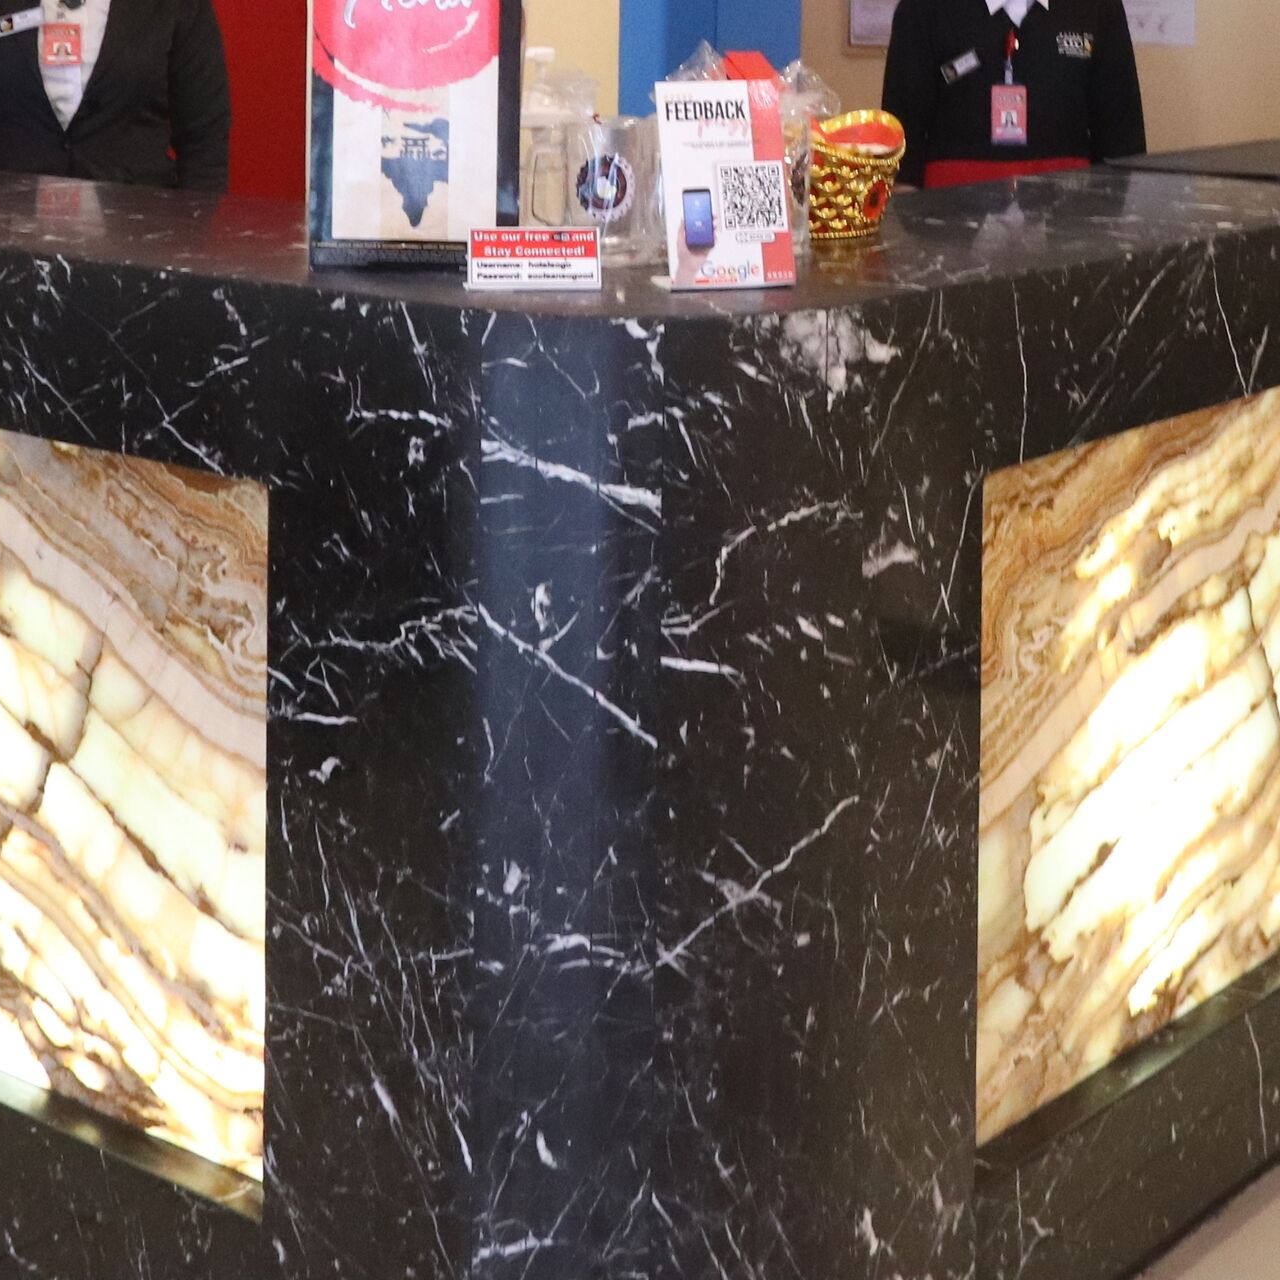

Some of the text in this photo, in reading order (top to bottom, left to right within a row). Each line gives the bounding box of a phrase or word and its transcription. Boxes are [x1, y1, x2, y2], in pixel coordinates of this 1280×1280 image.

[665, 99, 747, 121] FEEDBACK
[473, 231, 498, 241] Use
[501, 232, 521, 241] our
[524, 231, 549, 241] free
[571, 231, 594, 241] and
[484, 245, 585, 257] Stay Connected!
[701, 260, 760, 279] Google
